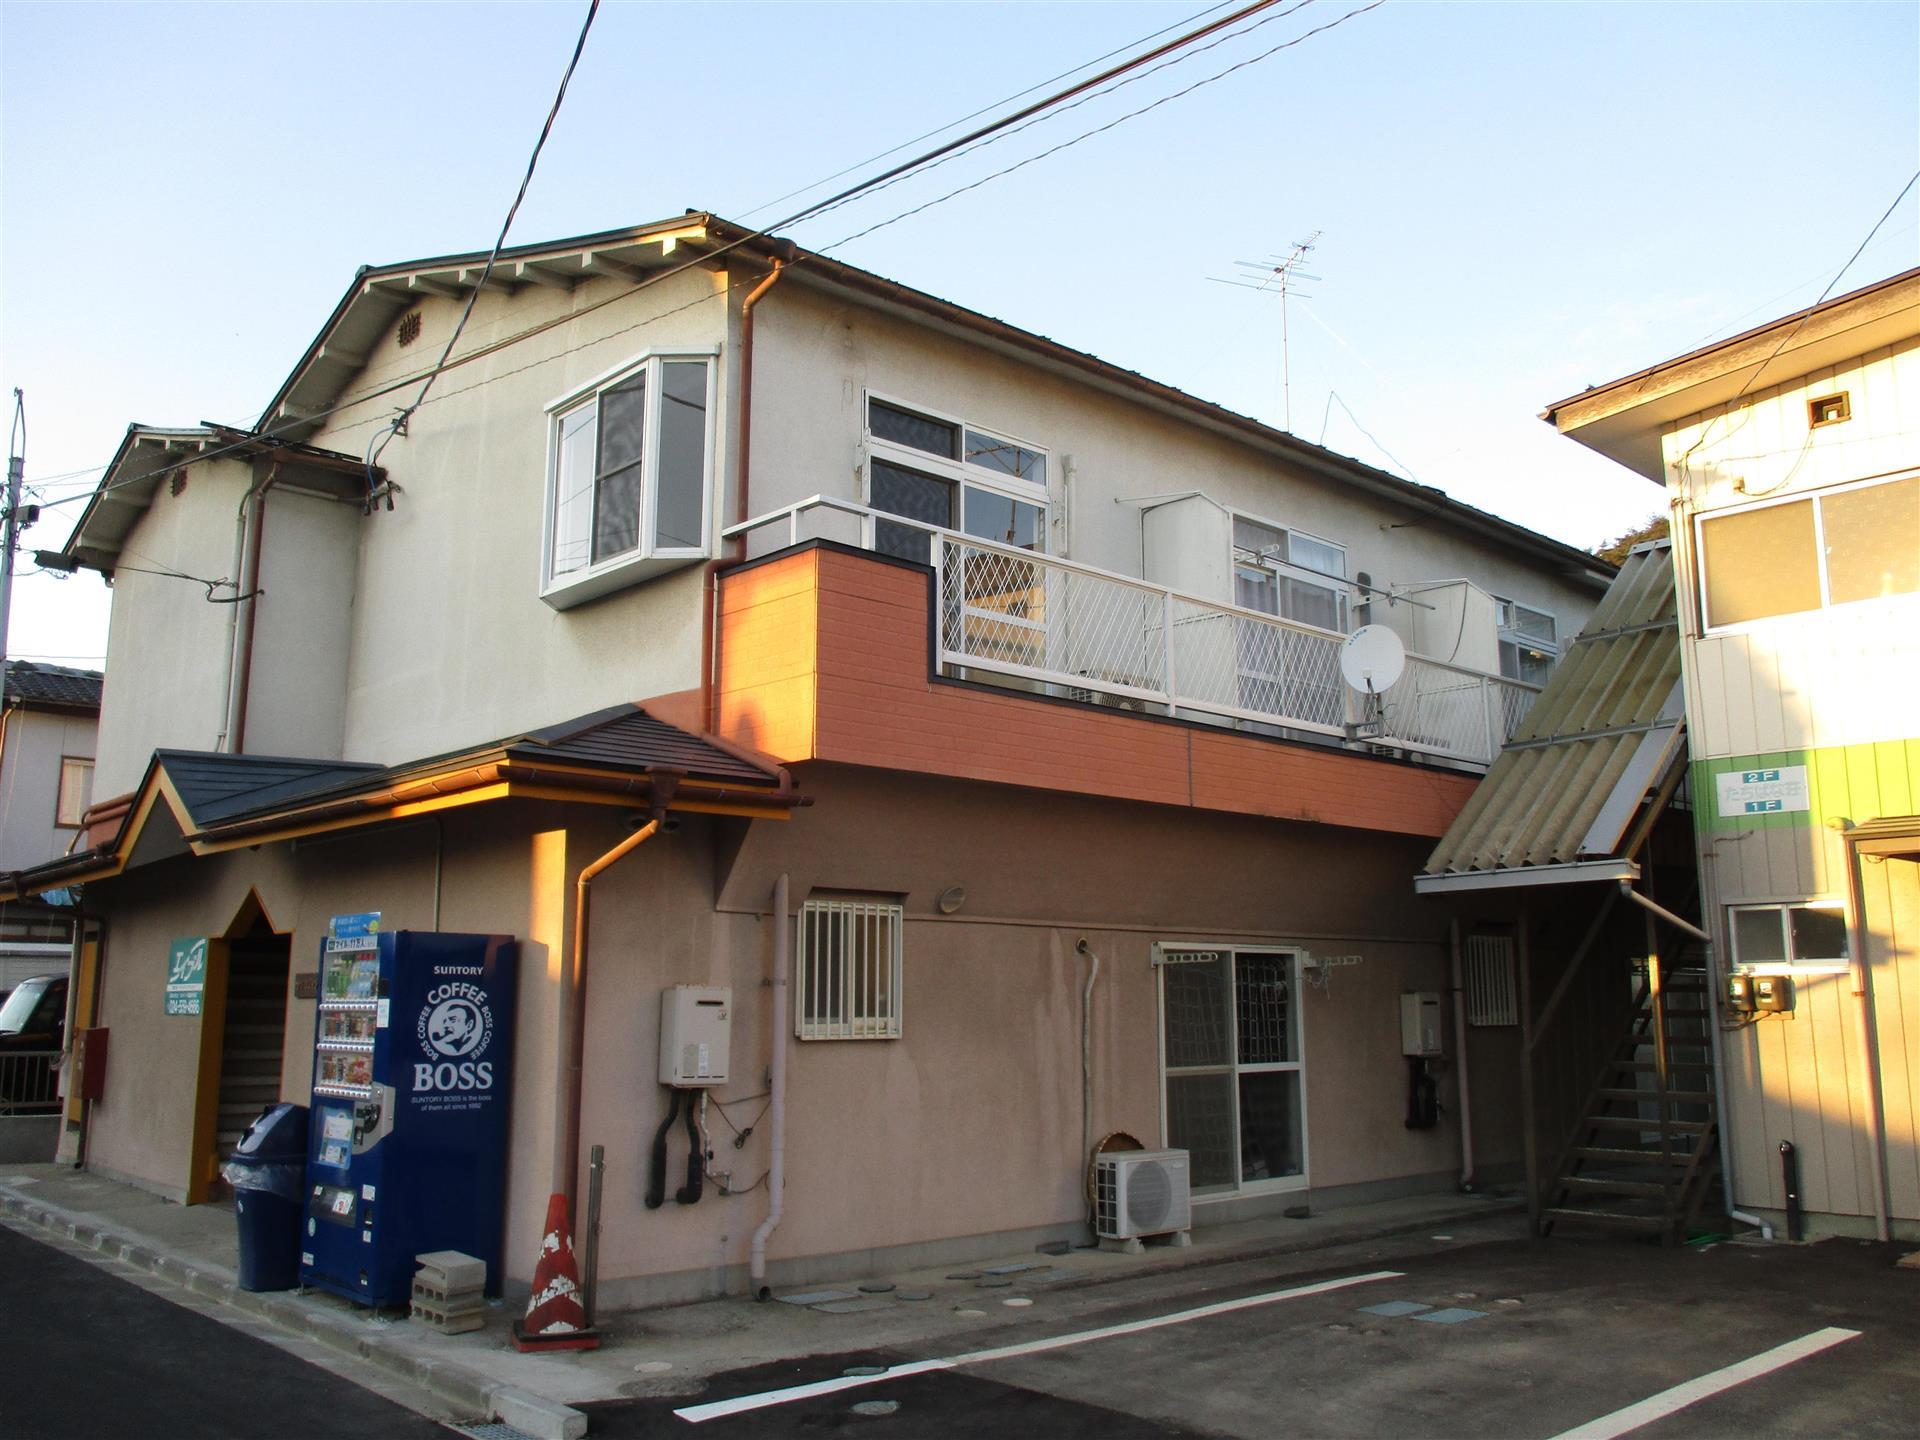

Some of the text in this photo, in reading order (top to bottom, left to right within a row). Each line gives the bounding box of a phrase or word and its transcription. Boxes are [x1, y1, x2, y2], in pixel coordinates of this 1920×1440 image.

[1748, 771, 1774, 783] 2F
[1752, 800, 1776, 811] 1F
[433, 965, 484, 975] SUNTORY
[427, 982, 488, 1006] COFFEE
[417, 1006, 439, 1061] BOSS COFFEE
[471, 1005, 493, 1060] BOSS COFFEE
[412, 1062, 493, 1091] BOSS
